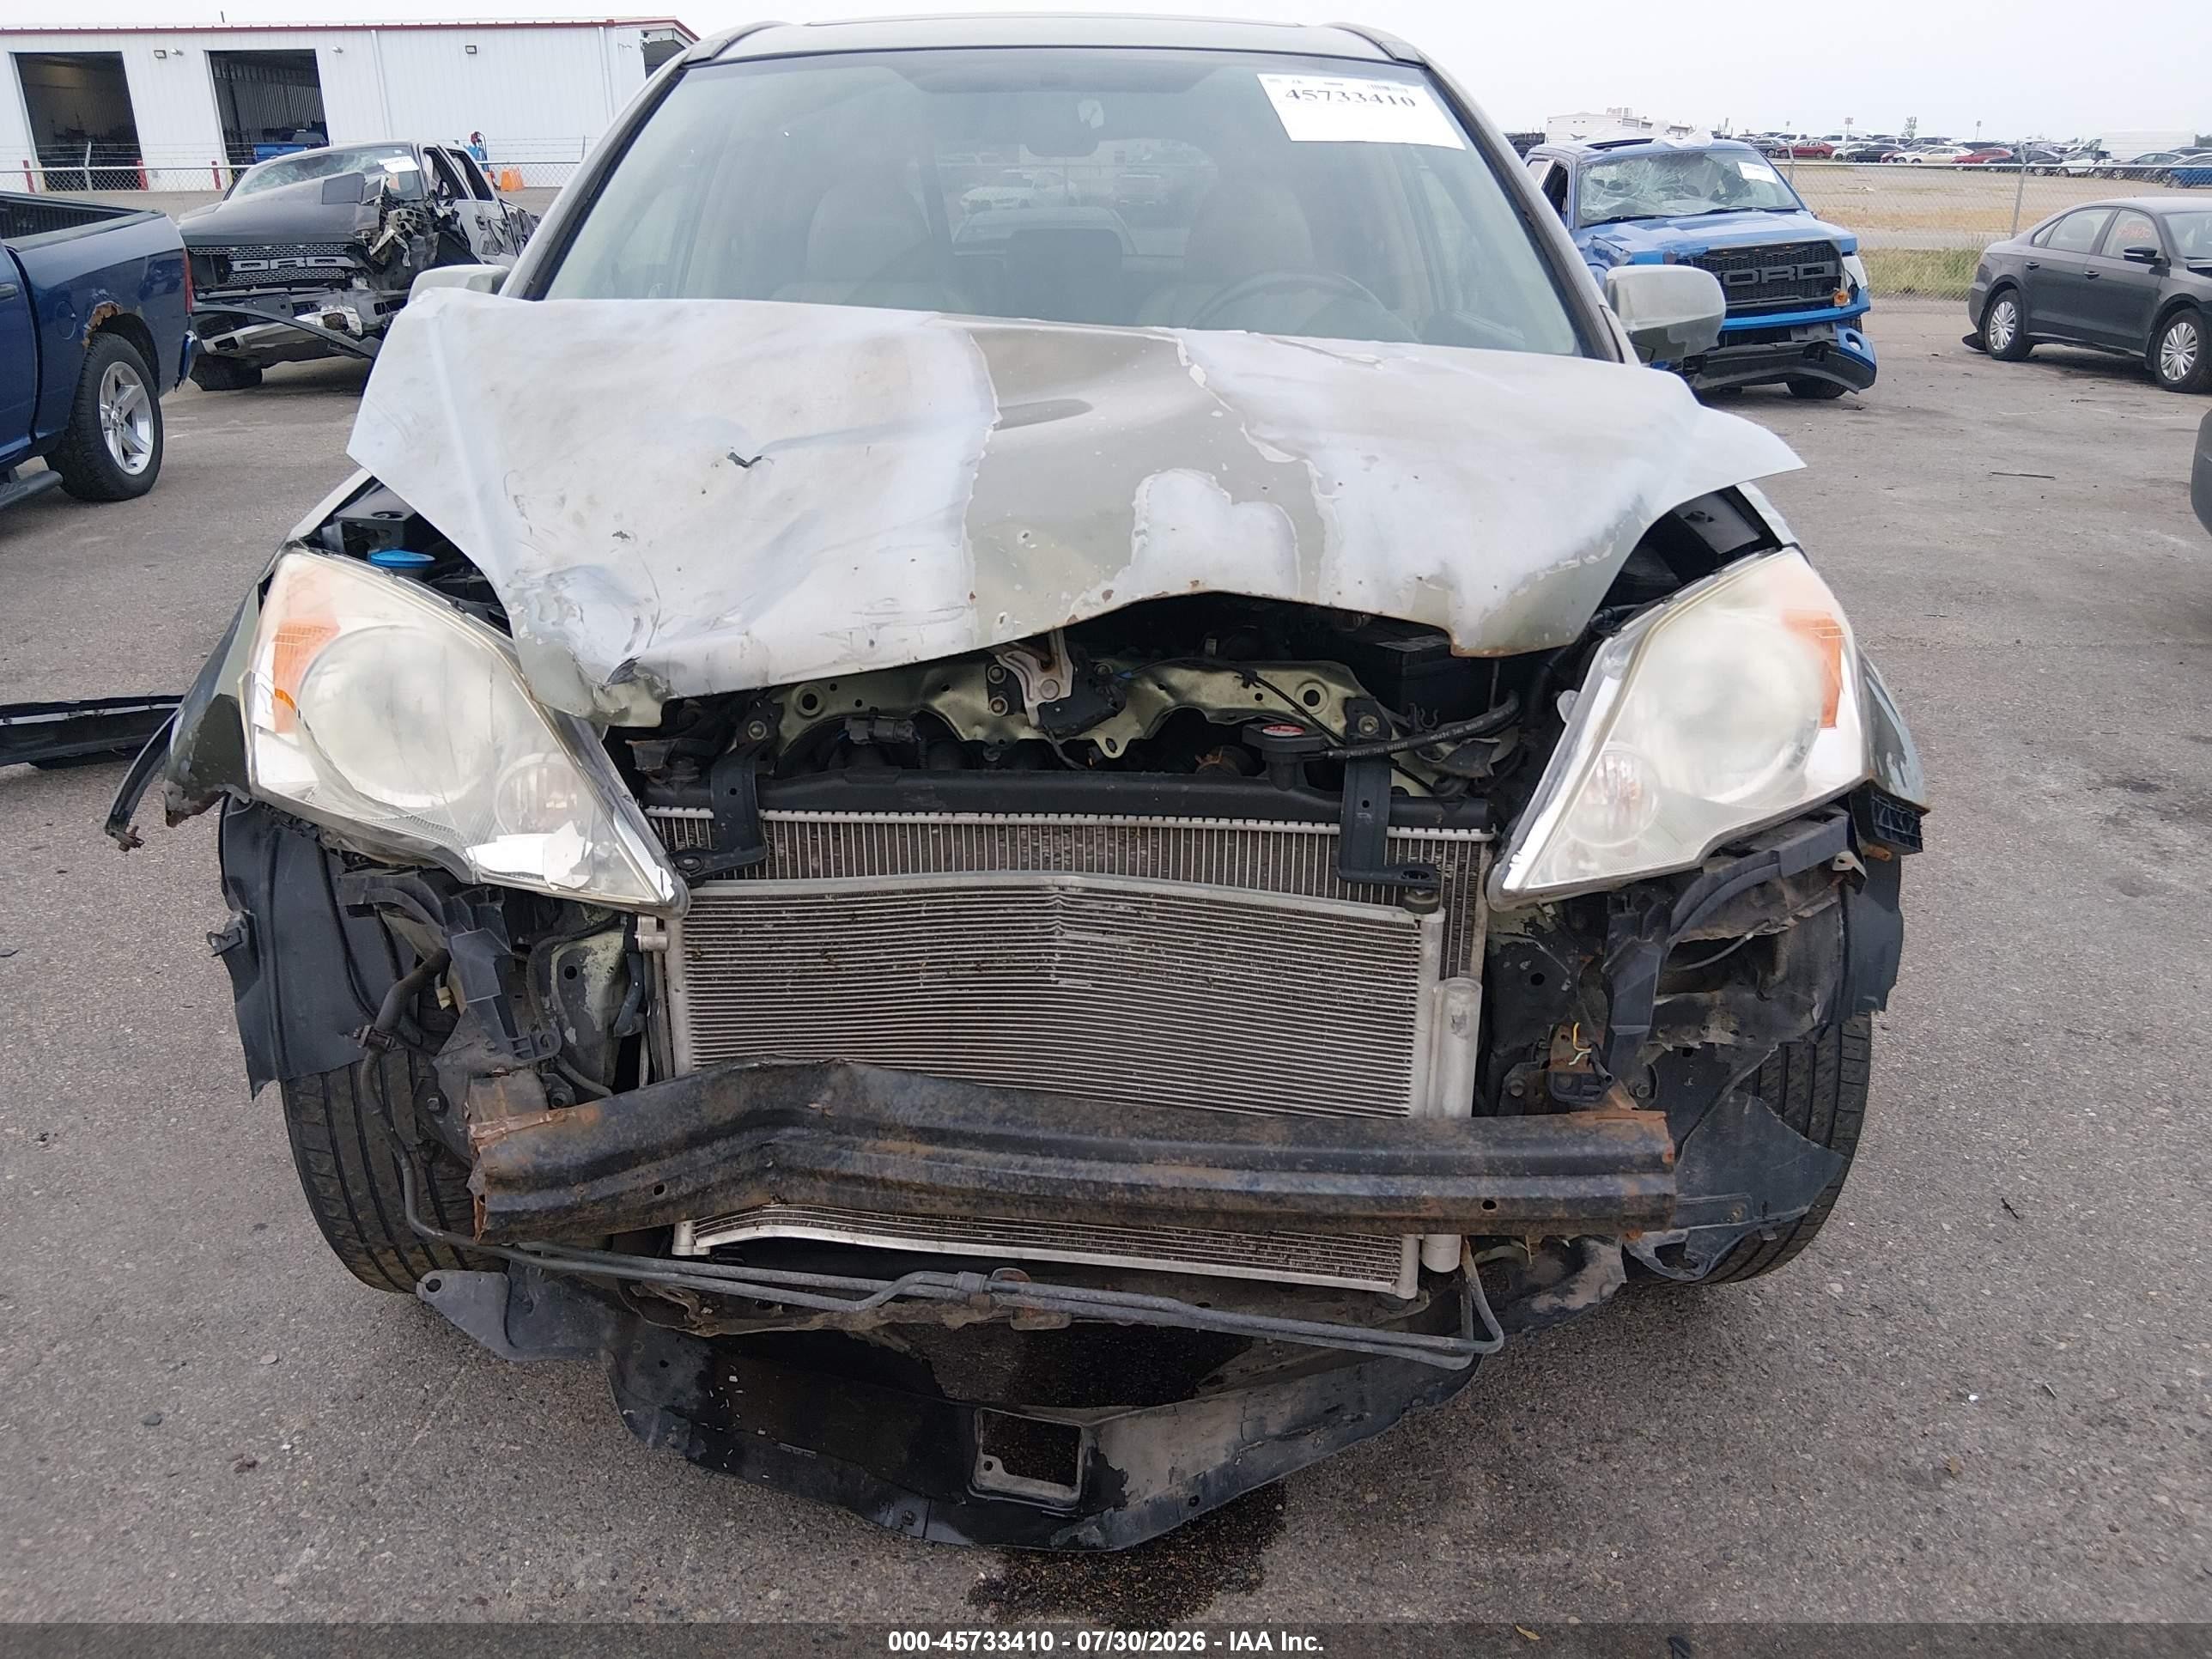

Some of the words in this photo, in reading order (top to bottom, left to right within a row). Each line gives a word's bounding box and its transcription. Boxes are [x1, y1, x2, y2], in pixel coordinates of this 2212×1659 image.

[1285, 88, 1416, 107] 45733410
[231, 256, 355, 272] ORD
[1722, 260, 1841, 287] ORD
